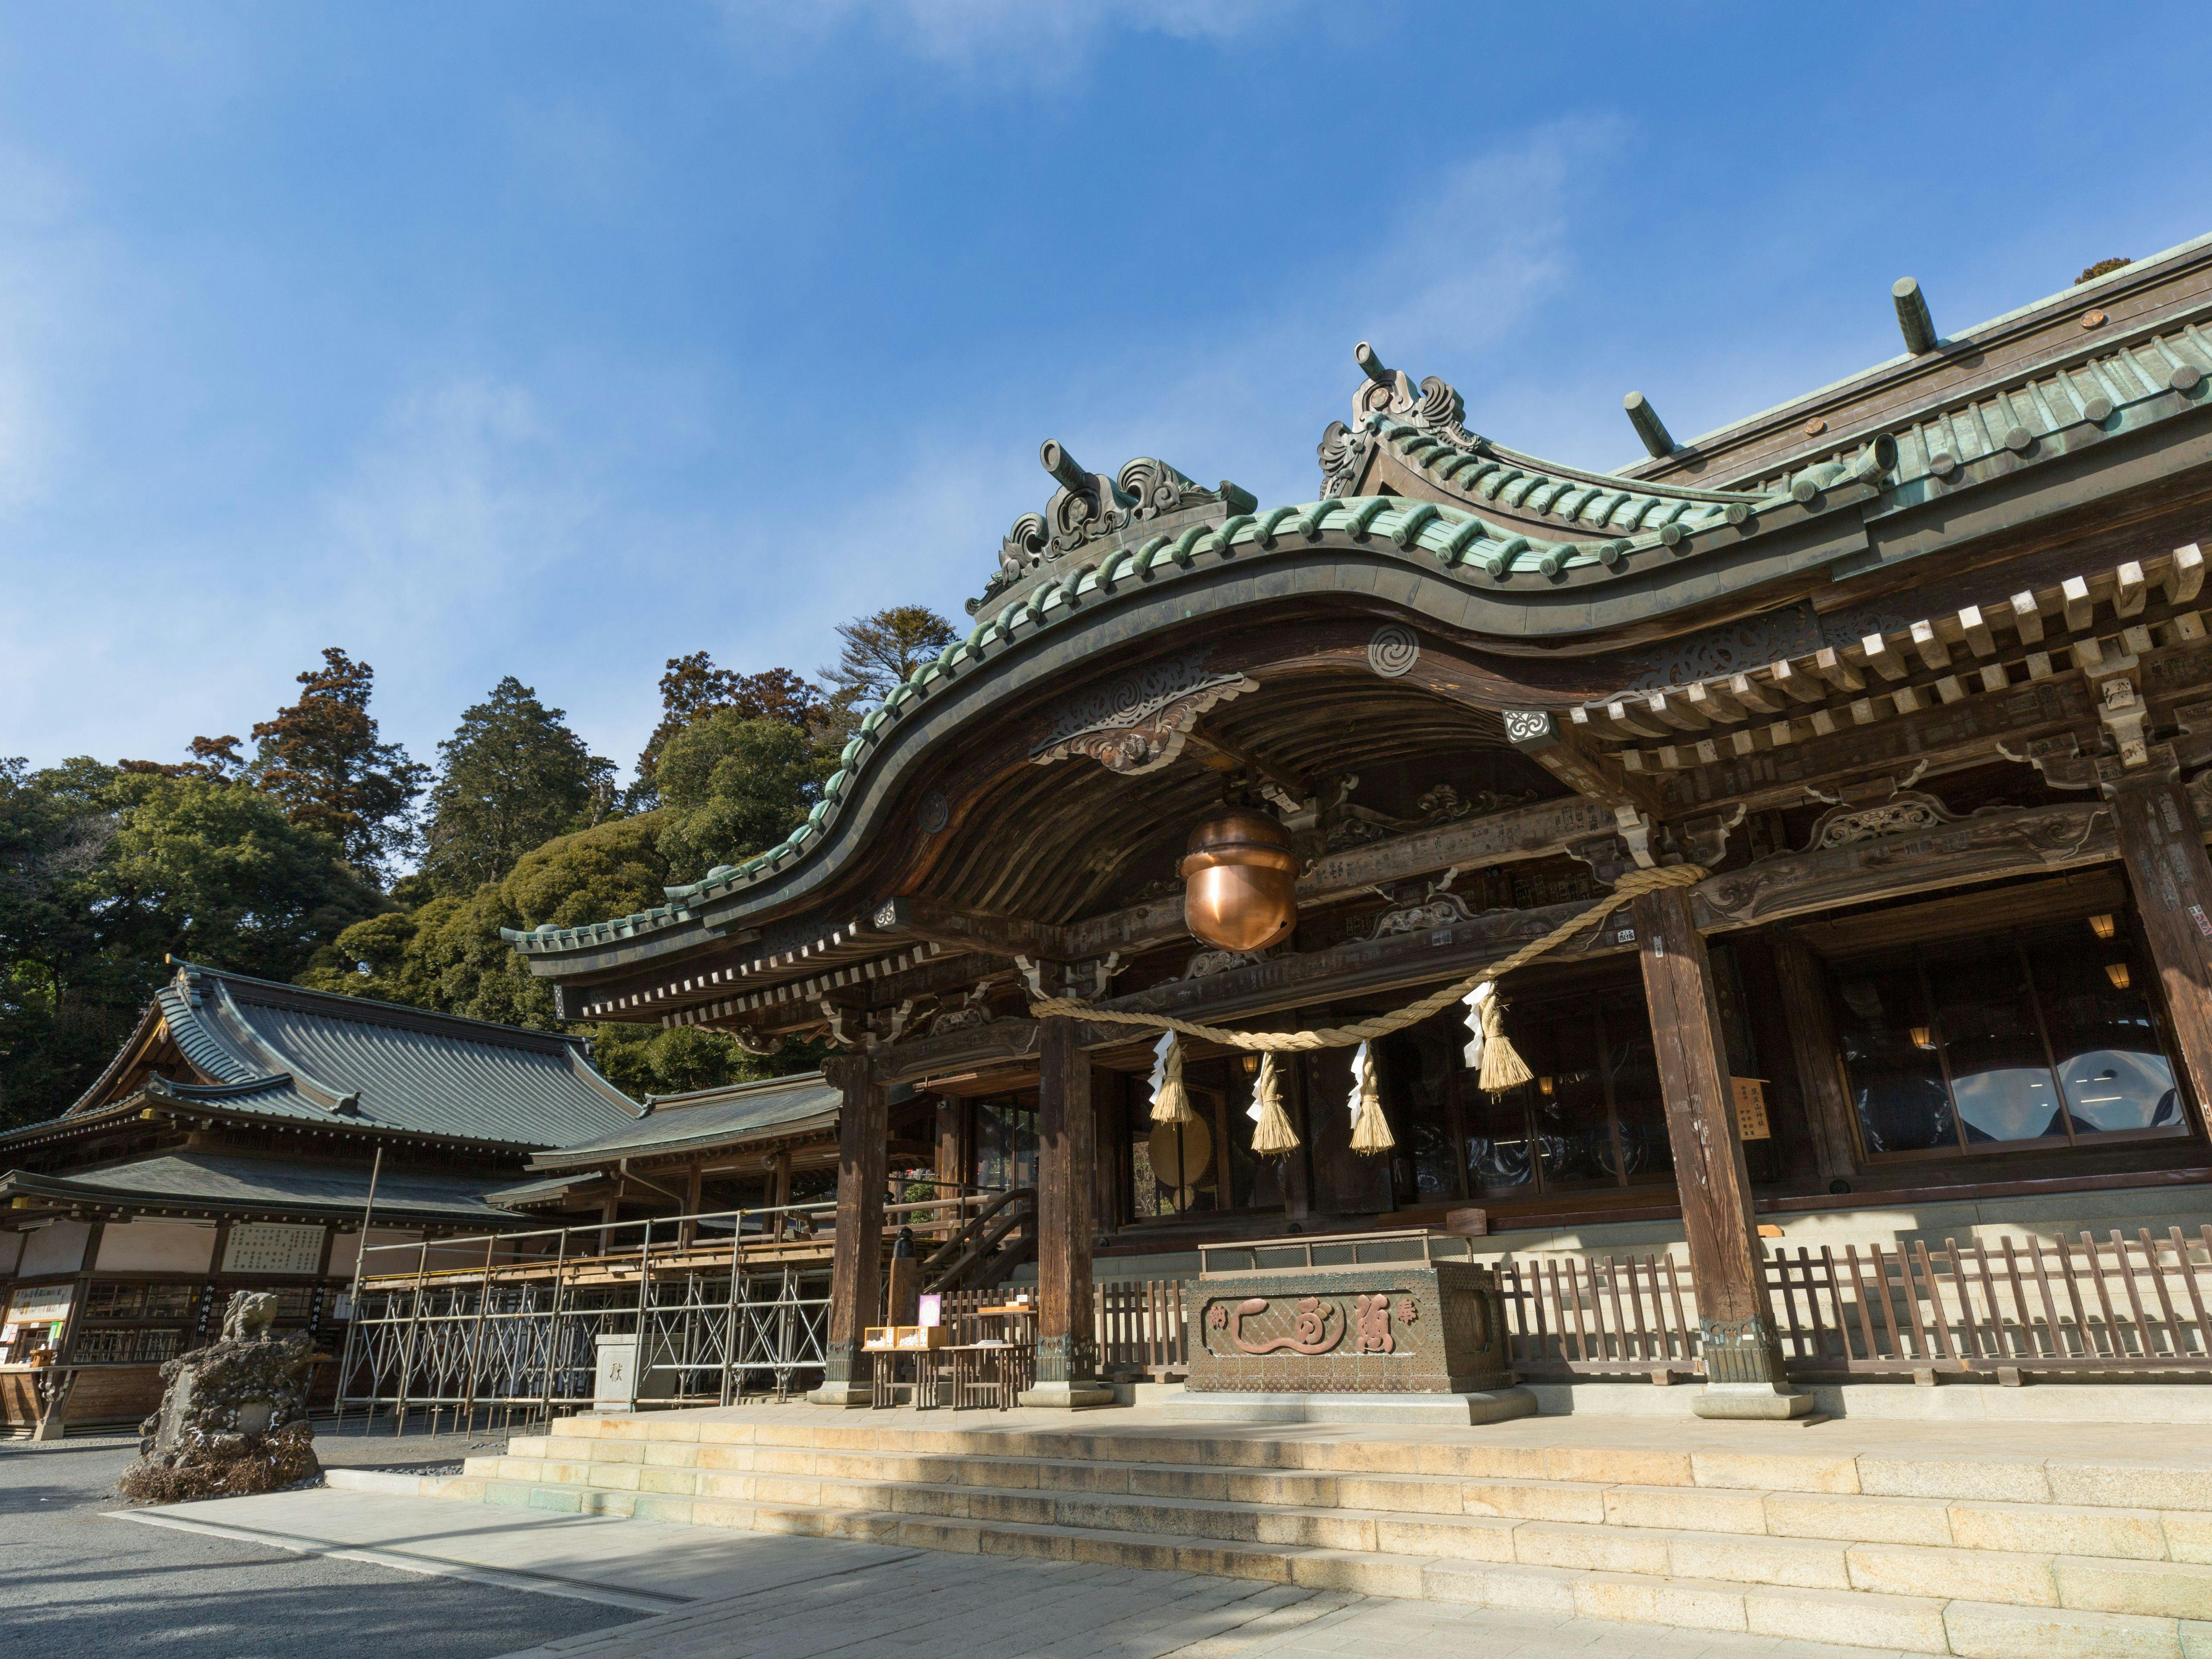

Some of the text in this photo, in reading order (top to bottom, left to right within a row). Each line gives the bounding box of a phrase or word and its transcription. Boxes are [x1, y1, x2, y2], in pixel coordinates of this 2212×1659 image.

[1751, 1087, 1765, 1127] 筑波山神社
[1397, 1299, 1417, 1324] 奉
